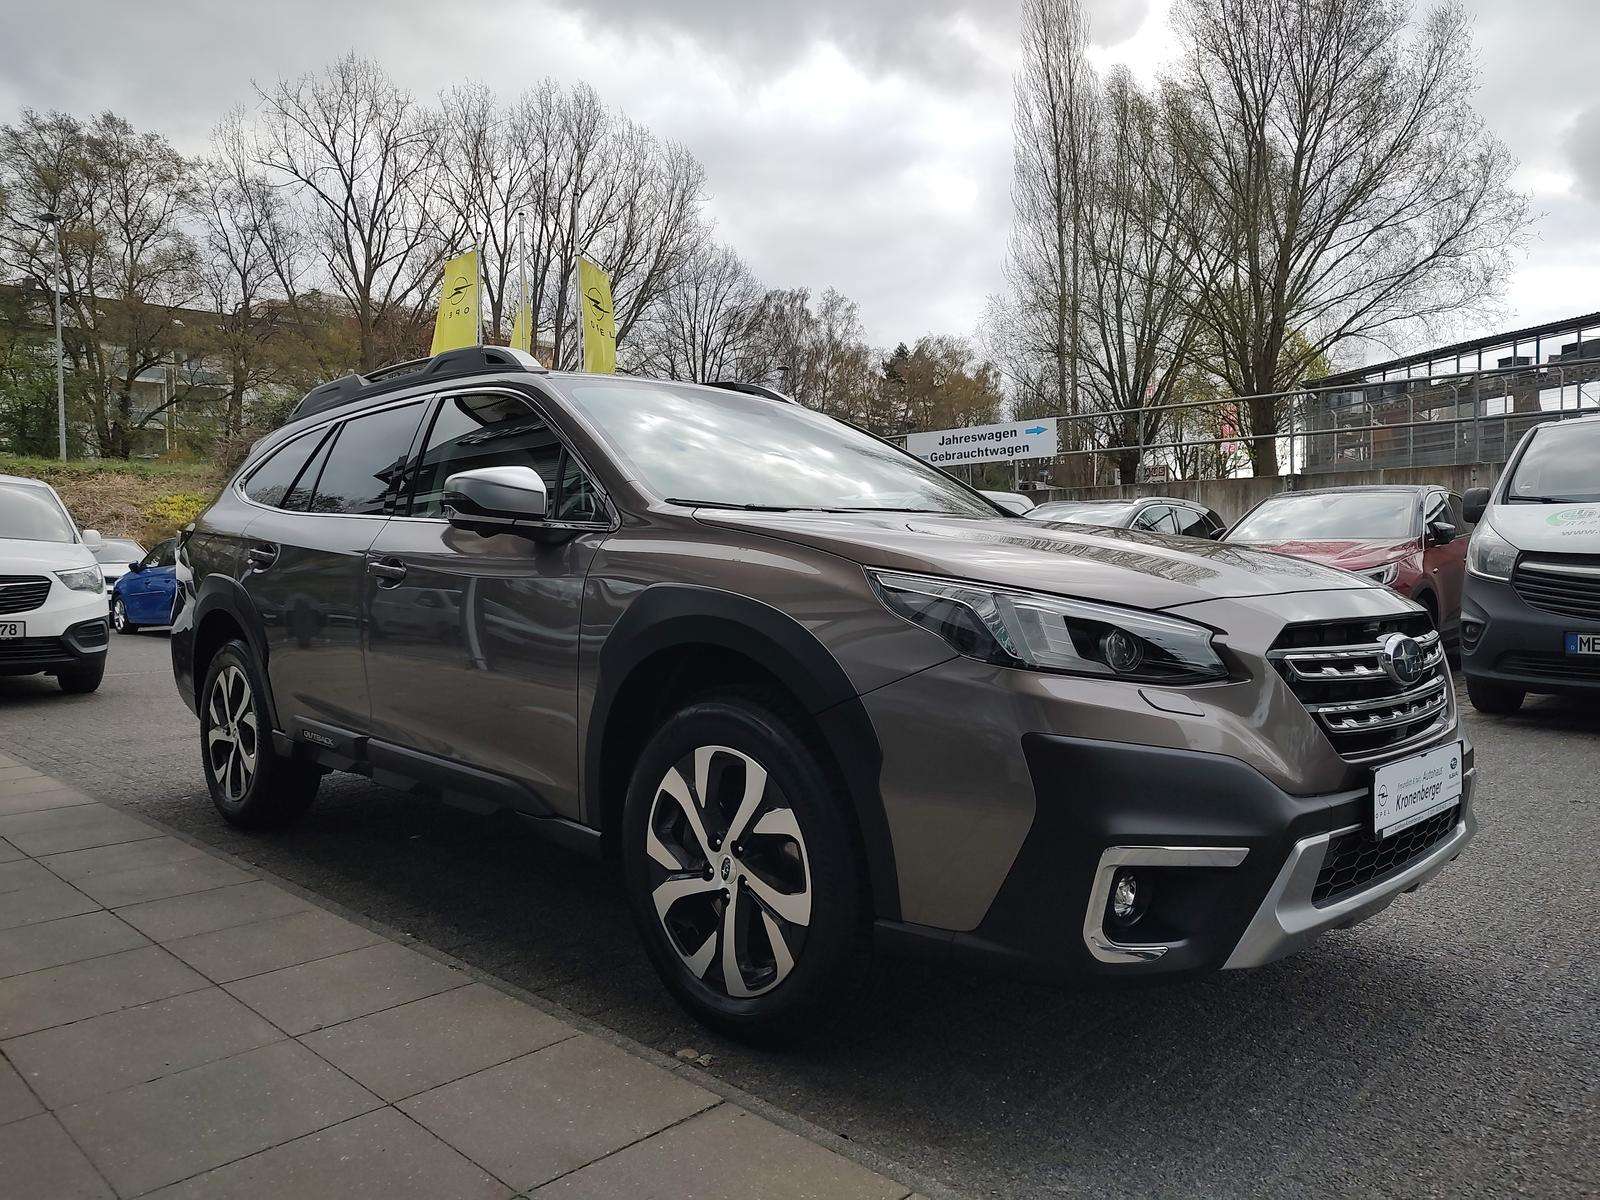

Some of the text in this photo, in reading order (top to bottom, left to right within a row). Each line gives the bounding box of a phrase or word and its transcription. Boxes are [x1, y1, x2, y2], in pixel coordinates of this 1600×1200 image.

[938, 429, 1017, 446] Jahreswagen
[930, 444, 1030, 462] Gebrauchtwagen
[0, 624, 17, 635] 78
[1395, 781, 1443, 812] Kronenberger
